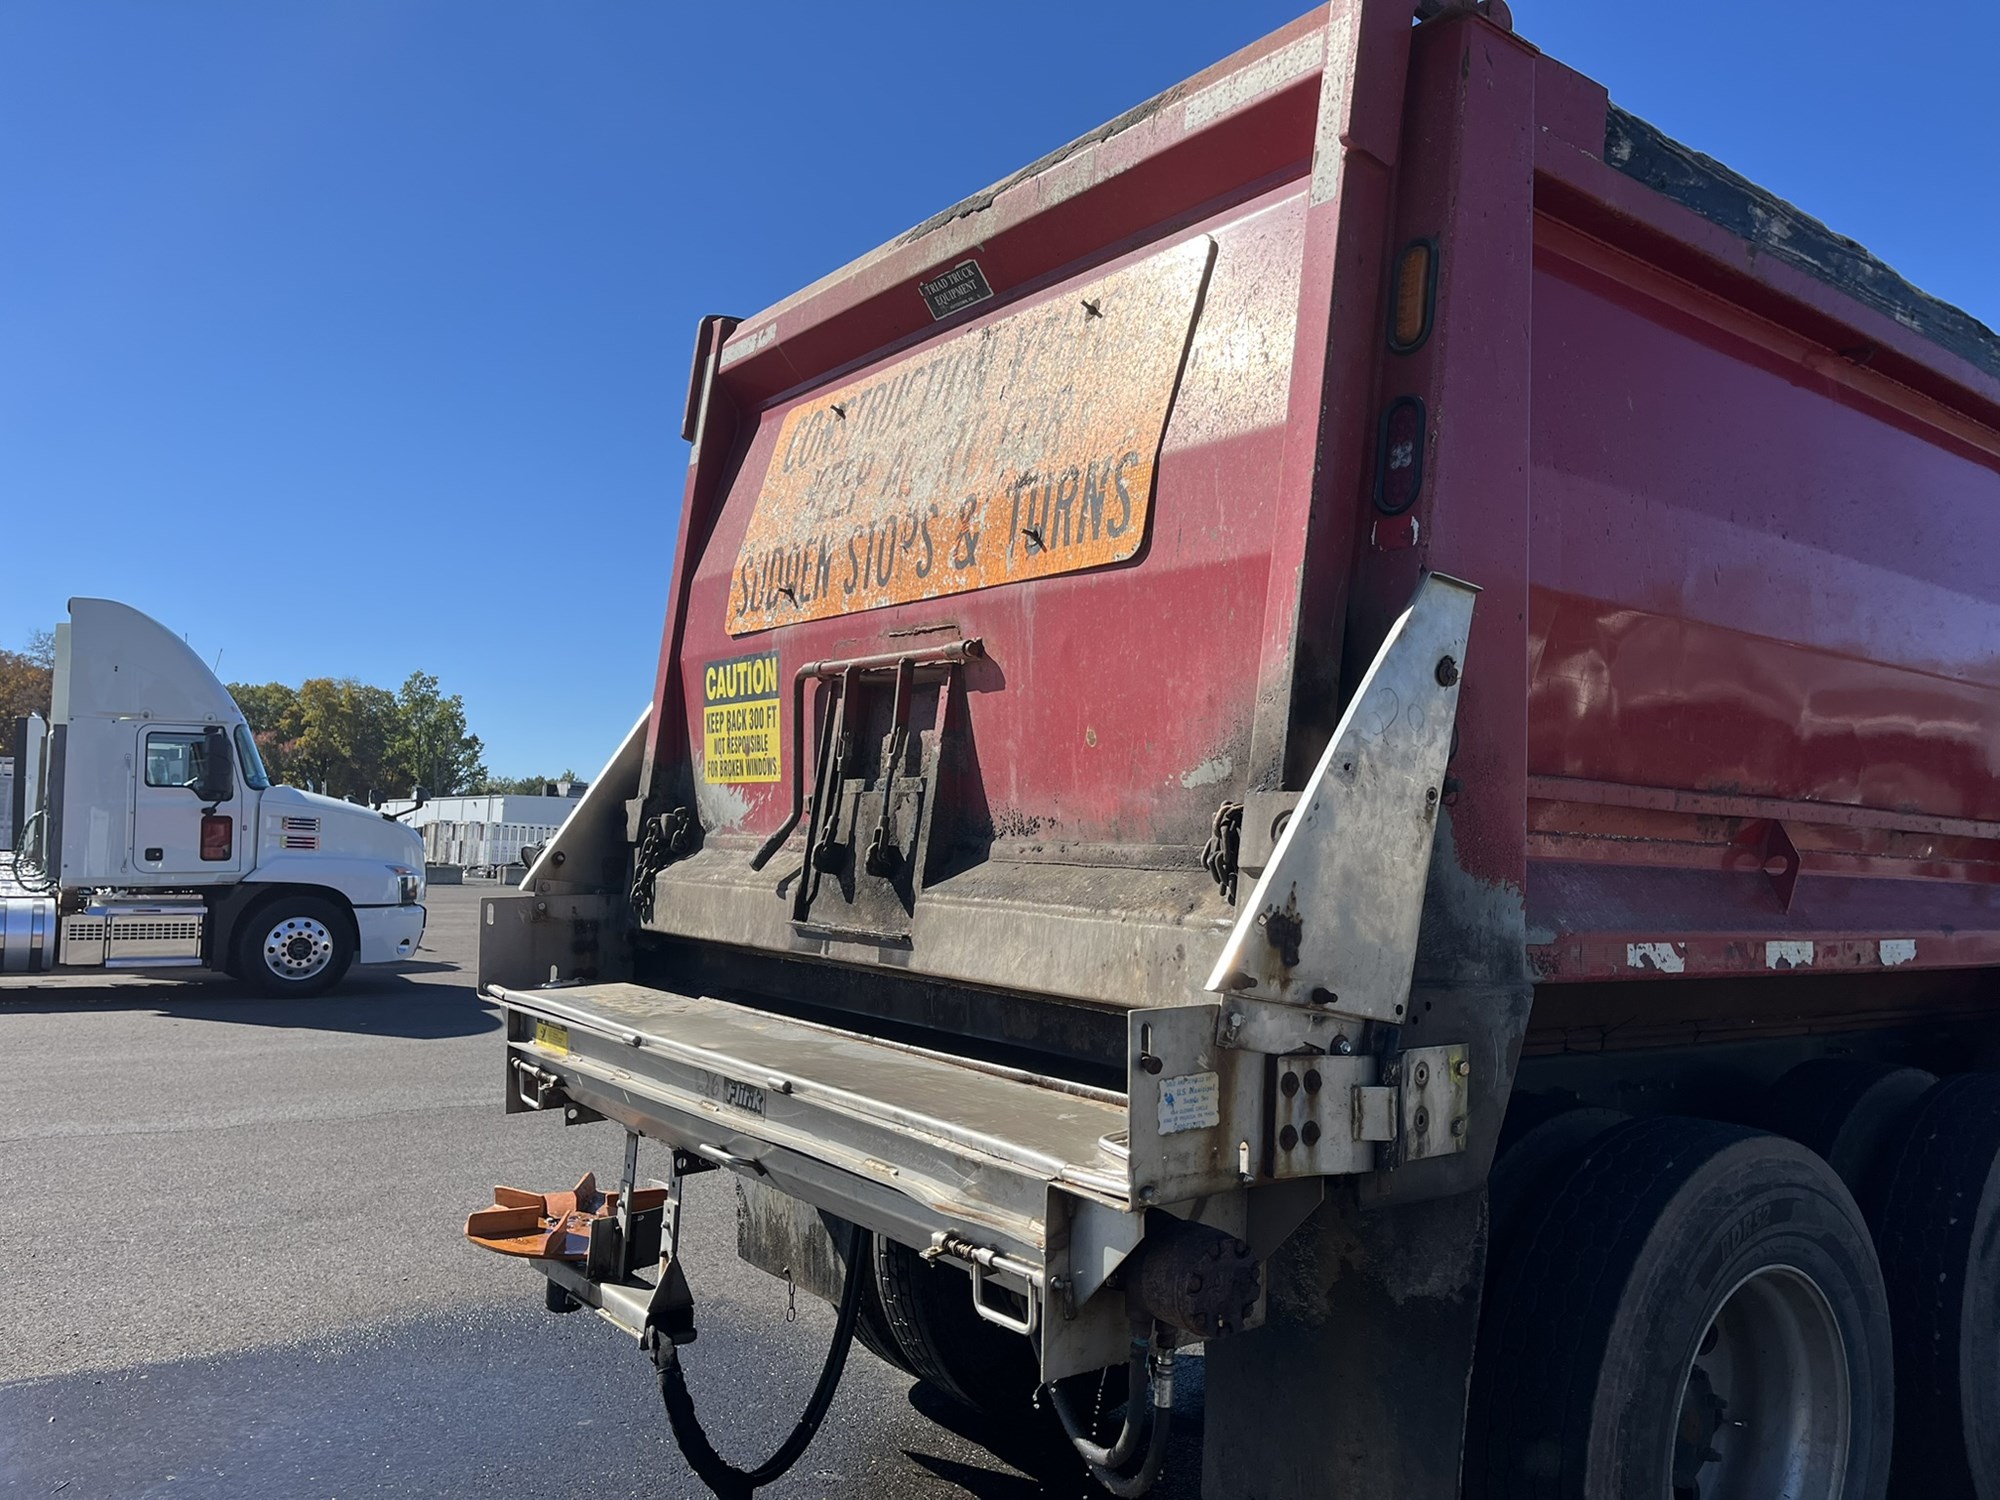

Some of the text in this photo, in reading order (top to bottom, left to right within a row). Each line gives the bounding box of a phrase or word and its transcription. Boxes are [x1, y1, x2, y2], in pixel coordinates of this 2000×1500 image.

[925, 265, 975, 295] TRIAD TRUCK
[934, 279, 977, 306] EQUIPMENT
[735, 450, 1139, 618] SUDDEN STOPS & TURNS
[705, 657, 777, 700] CAUTION
[706, 705, 777, 734] KEEP BACK 300 FT
[714, 734, 768, 755] NOT RESPONSIBLE
[707, 757, 777, 778] FOR BROKEN WINDOWS
